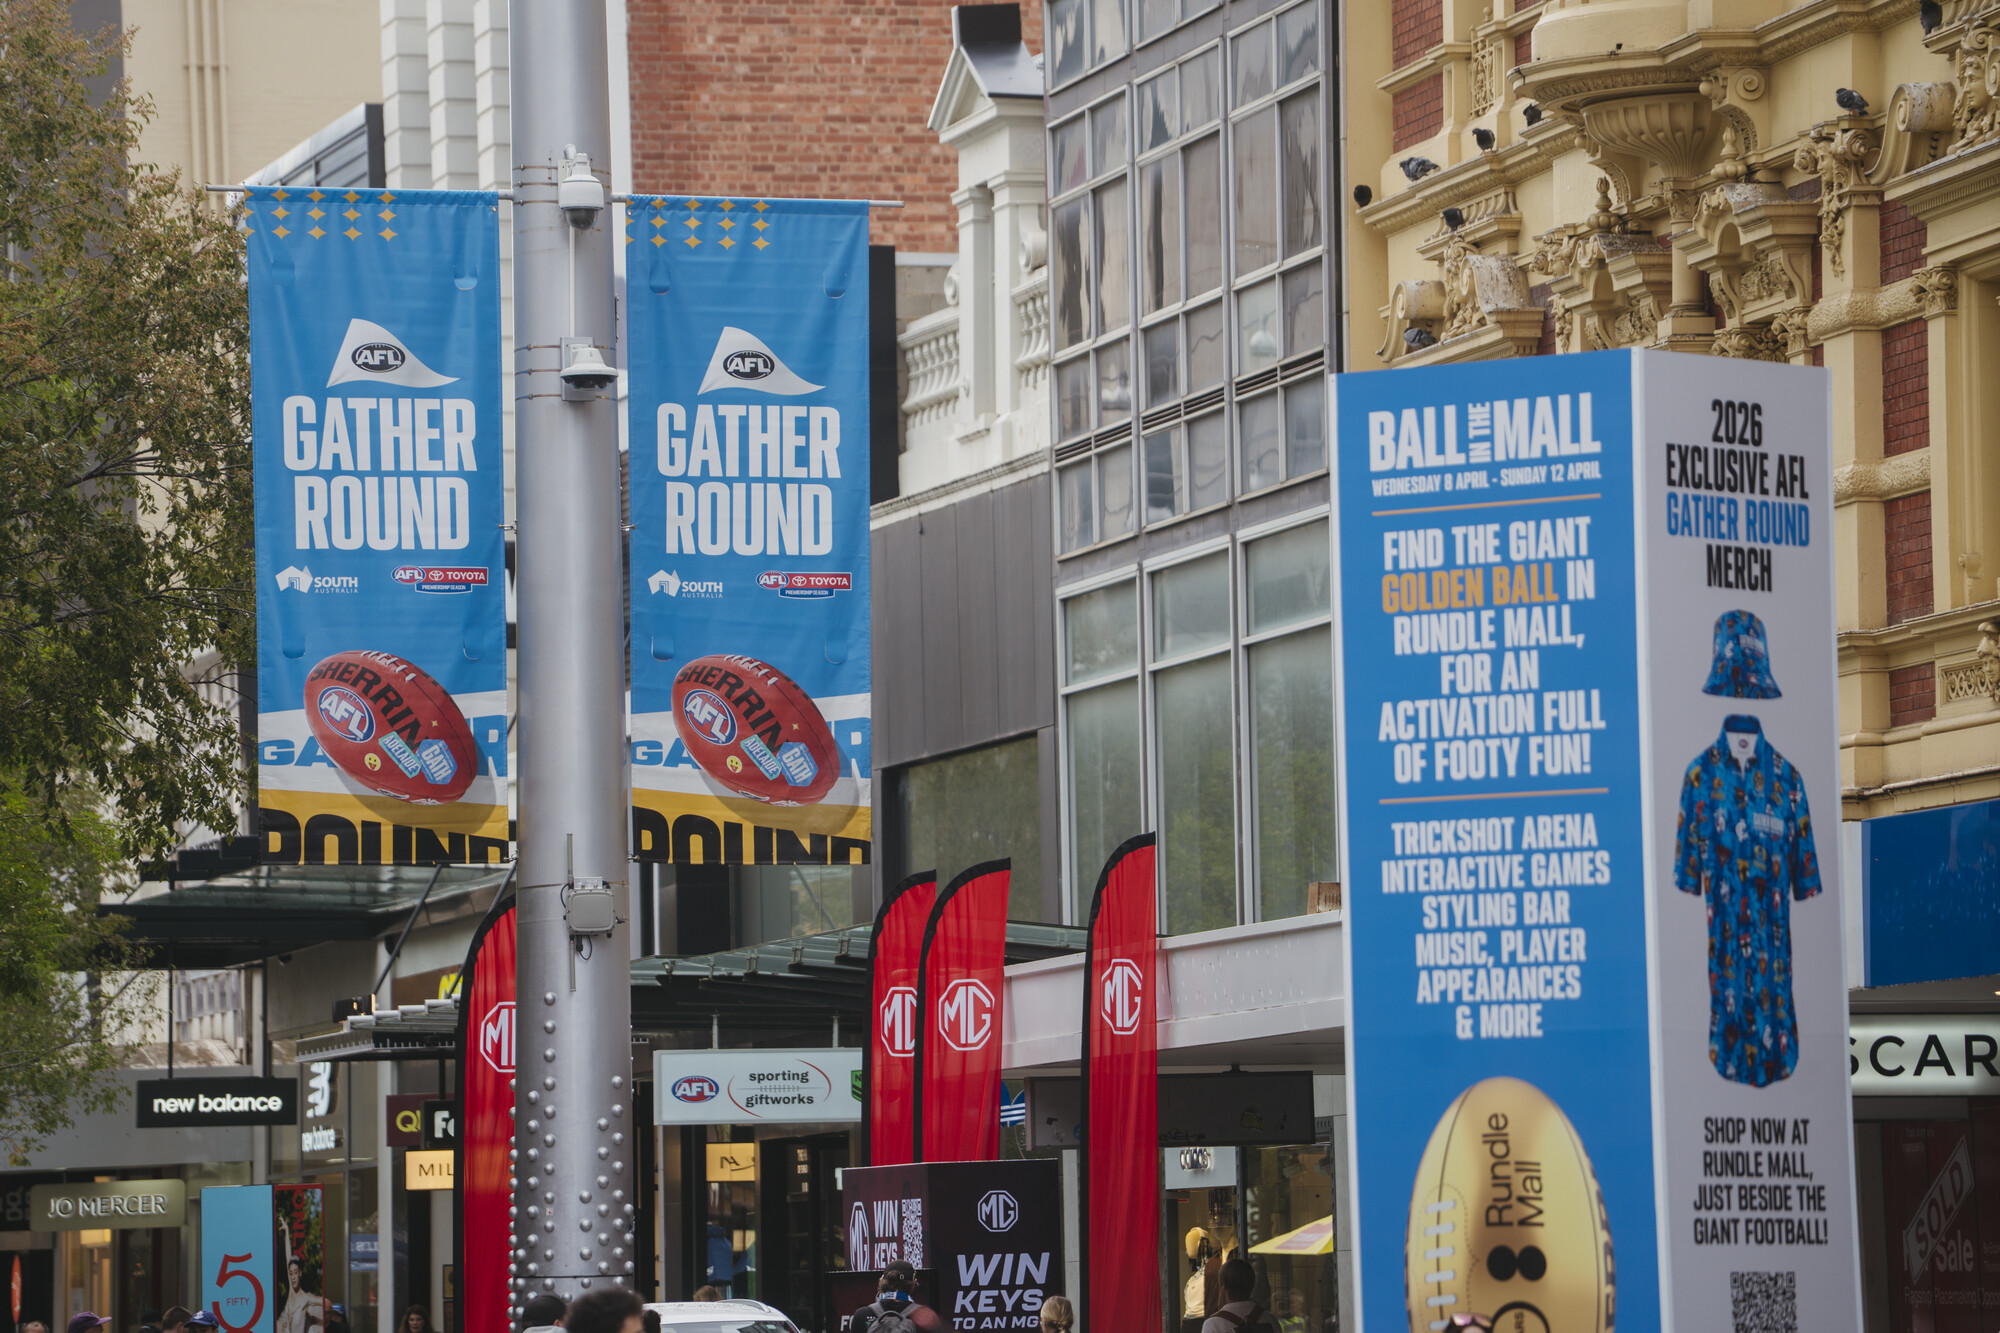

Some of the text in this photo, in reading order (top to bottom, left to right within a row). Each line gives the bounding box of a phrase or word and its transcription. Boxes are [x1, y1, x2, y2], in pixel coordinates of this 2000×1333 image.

[356, 348, 403, 366] AFL
[726, 356, 771, 374] AFL
[282, 394, 478, 472] GATHER
[656, 402, 842, 480] GATHER
[1368, 392, 1602, 472] BALL IN THE MALL
[1711, 398, 1763, 447] 2026
[1372, 473, 1442, 498] WEDNESDAY
[1444, 473, 1453, 491] 8
[1454, 470, 1490, 491] APRIL
[1500, 466, 1548, 488] SUNDAY
[1550, 464, 1564, 483] 12
[1566, 460, 1602, 482] APRIL
[1666, 442, 1809, 500] EXCLUSIVE AFL
[294, 475, 470, 552] ROUND
[665, 482, 834, 558] ROUND
[1666, 492, 1810, 548] GATHER ROUND
[1383, 516, 1591, 572] FIND THE GIANT
[314, 576, 358, 588] SOUTH
[394, 570, 486, 581] AFL TOYOTA
[682, 581, 723, 593] SOUTH
[759, 575, 848, 586] AFL TOYOTA
[1382, 559, 1596, 614] GOLDEN BALL IN
[1706, 544, 1772, 593] MERCH
[1394, 604, 1585, 656] RUNDLE MALL,
[1440, 650, 1539, 696] FOR AN
[319, 692, 366, 741] AFL
[685, 695, 729, 743] AFL
[1378, 689, 1606, 742] ACTIVATION FULL
[382, 734, 419, 774] ADELAIDE
[744, 737, 780, 776] ADELAIDE
[1394, 733, 1592, 781] OF FOOTY FUN!
[1391, 813, 1598, 856] TRICKSHOT ARENA
[1381, 850, 1610, 894] INTERACTIVE GAMES
[1422, 890, 1571, 930] STYLING BAR
[1415, 927, 1586, 969] MUSIC, PLAYER
[1104, 966, 1141, 1028] MG
[1416, 966, 1581, 1005] APPEARANCES
[942, 987, 992, 1043] MG
[1456, 1003, 1544, 1040] & MORE
[675, 1082, 716, 1097] AFL
[748, 1070, 810, 1084] sporting
[153, 1092, 282, 1114] new balance
[745, 1093, 814, 1108] giftworks
[1704, 1116, 1810, 1145] SHOP NOW AT
[1482, 1112, 1514, 1228] Rundle
[1702, 1151, 1814, 1182] RUNDLE MALL,
[48, 1198, 74, 1218] JO
[79, 1194, 167, 1217] MERCER
[981, 1194, 1015, 1229] MG
[1514, 1160, 1546, 1228] Mall
[1693, 1184, 1826, 1212] JUST BESIDE THE
[1915, 1160, 1964, 1260] SOLD
[292, 1190, 306, 1260] ONLY
[873, 1200, 898, 1238] WIN
[1693, 1218, 1828, 1246] GIANT FOOTBALL!
[874, 1242, 898, 1269] KEYS
[956, 1252, 1050, 1286] WIN
[1936, 1230, 1974, 1272] Sale
[226, 1297, 250, 1306] FIFTY
[954, 1288, 1044, 1314] KEYS
[952, 1317, 976, 1330] TO
[980, 1316, 1006, 1329] AN
